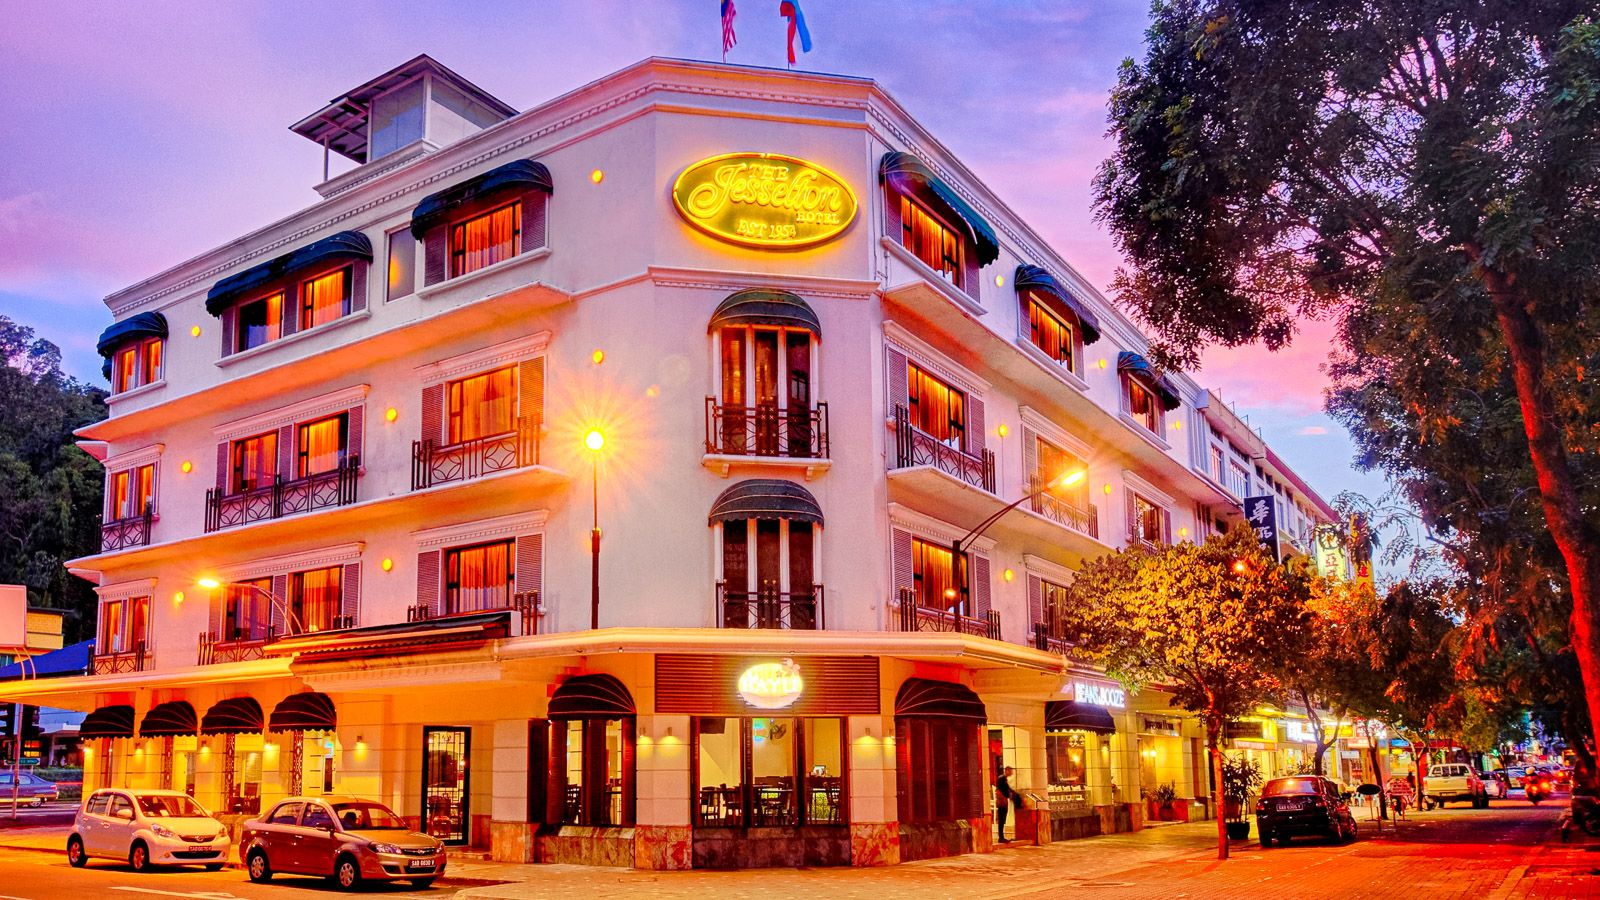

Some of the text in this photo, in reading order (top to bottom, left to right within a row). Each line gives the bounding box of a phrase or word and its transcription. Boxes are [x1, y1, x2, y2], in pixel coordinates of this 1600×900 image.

[749, 164, 789, 181] THE
[687, 162, 842, 219] Jesselton
[796, 211, 840, 224] HOTEL
[735, 219, 766, 237] EST
